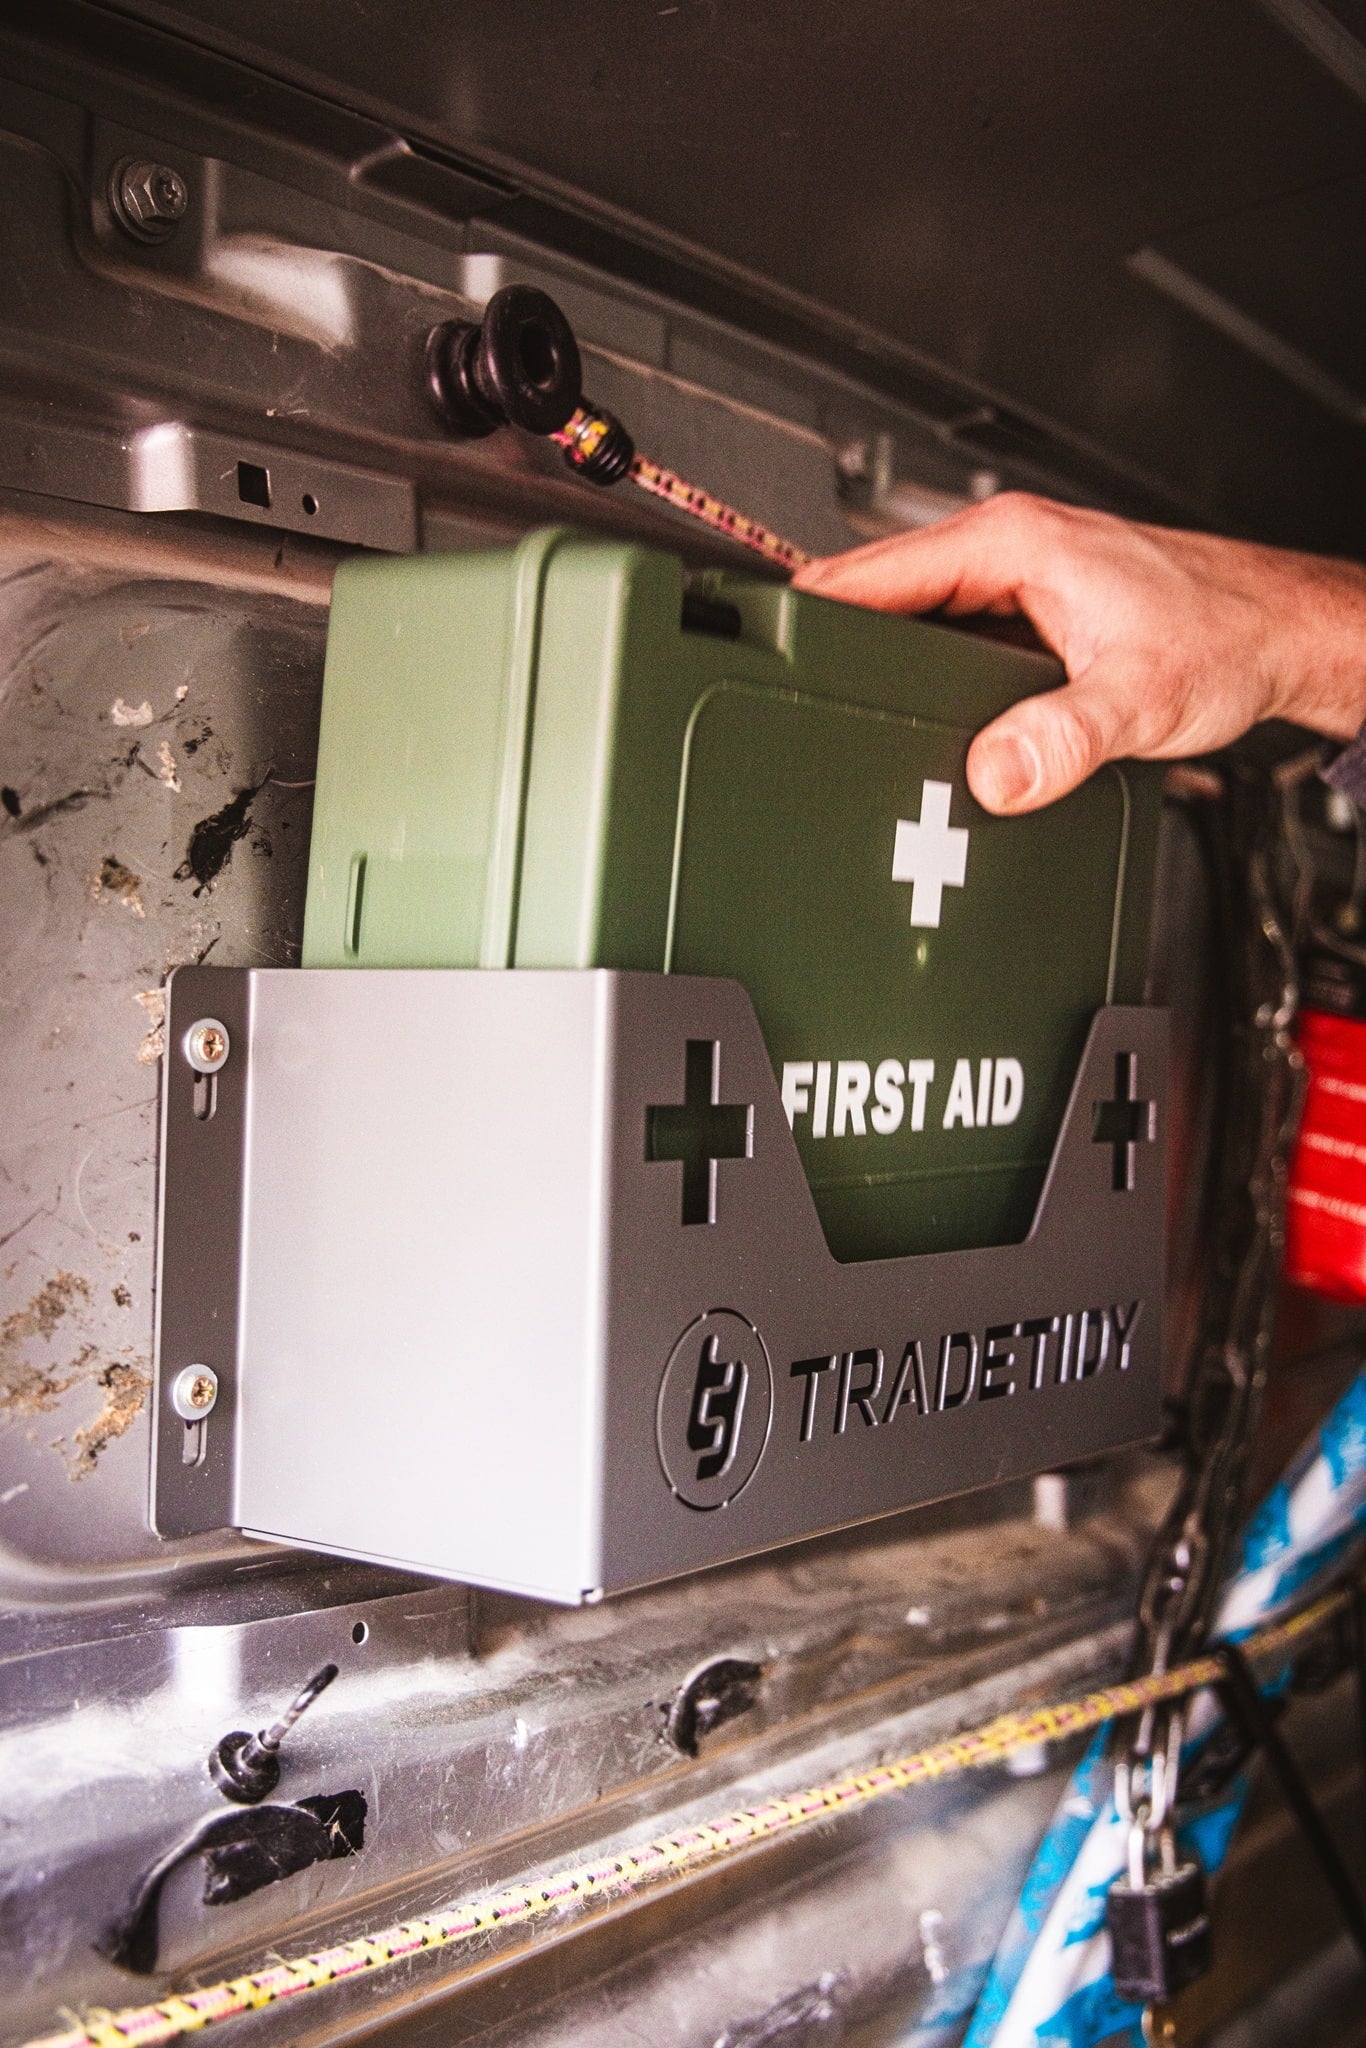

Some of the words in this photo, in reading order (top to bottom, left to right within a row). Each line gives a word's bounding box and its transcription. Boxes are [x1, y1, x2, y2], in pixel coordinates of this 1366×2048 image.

[781, 1058, 935, 1139] FIRST
[942, 1057, 1024, 1130] AID
[789, 1299, 1144, 1442] TRADETIDY
